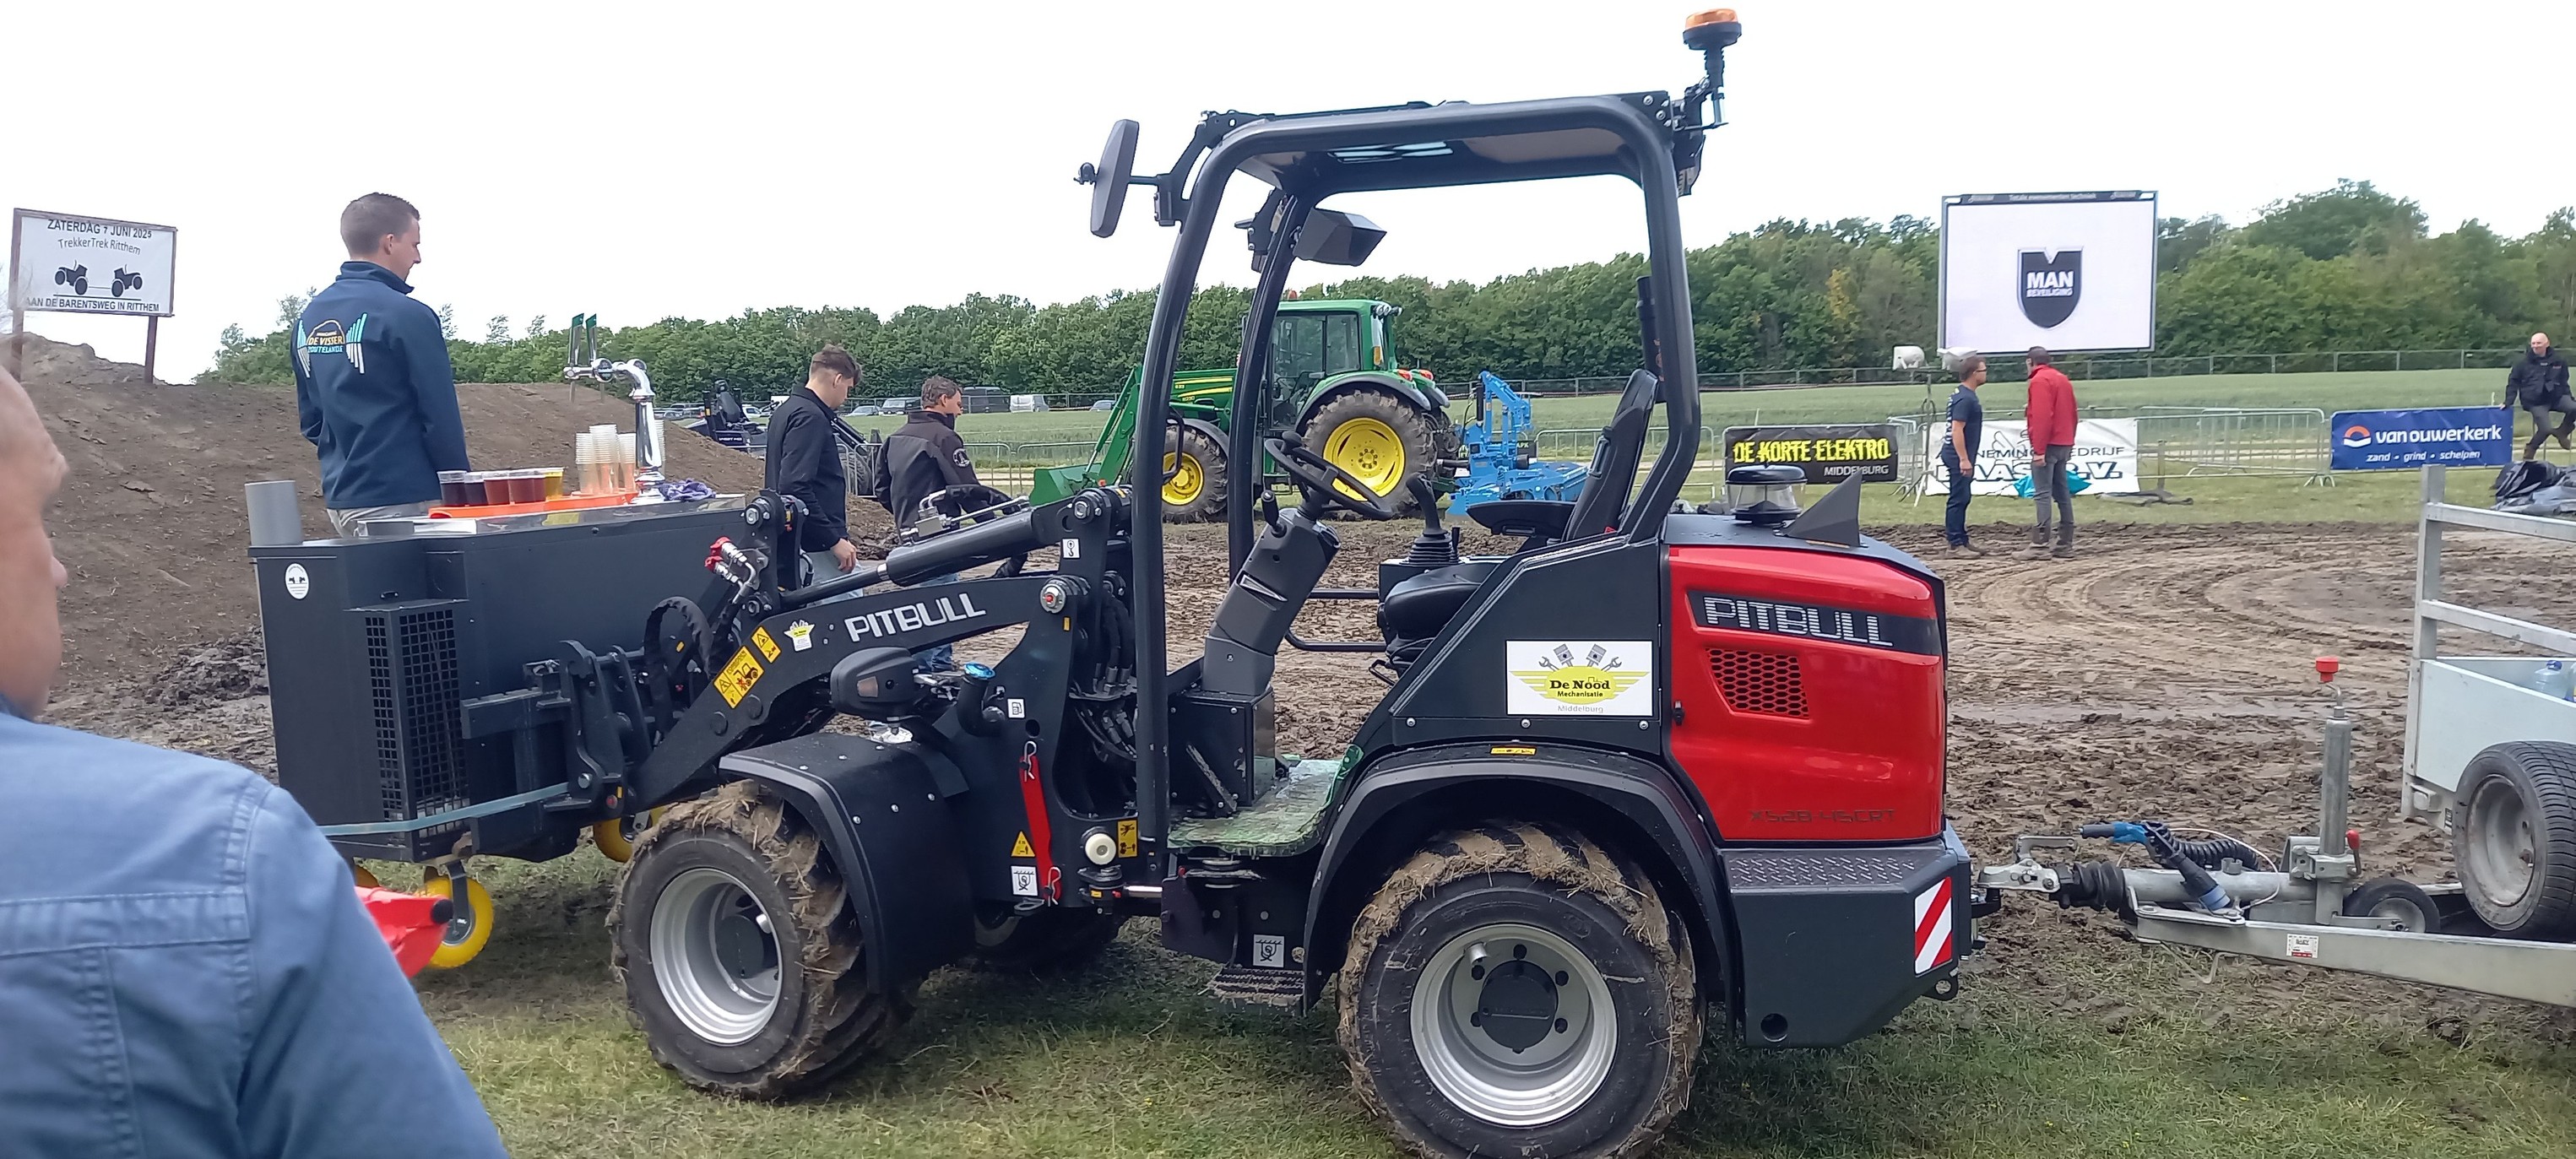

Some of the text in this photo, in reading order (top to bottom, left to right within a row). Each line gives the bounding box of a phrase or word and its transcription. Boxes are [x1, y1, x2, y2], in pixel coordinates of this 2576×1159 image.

[47, 219, 100, 234] ZATERDAG
[110, 226, 131, 237] JUNI
[133, 228, 152, 239] 2025
[57, 236, 141, 255] TrekkerTrek Ritthem
[2027, 270, 2074, 289] MAN
[45, 298, 57, 306] DE
[59, 298, 116, 310] BARENTSWEG
[127, 302, 160, 311] RITTHEM
[320, 336, 343, 345] VISSER
[2376, 425, 2502, 444] van ouwerkerk
[1733, 438, 1891, 463] DE KORTE ELEKTRO
[2366, 450, 2481, 463] zand grind schelpen
[1824, 465, 1889, 476] MIDDEBURG
[844, 593, 986, 642] PITBULL
[1704, 597, 1893, 647] PITBULL
[1549, 680, 1611, 690] De Nood
